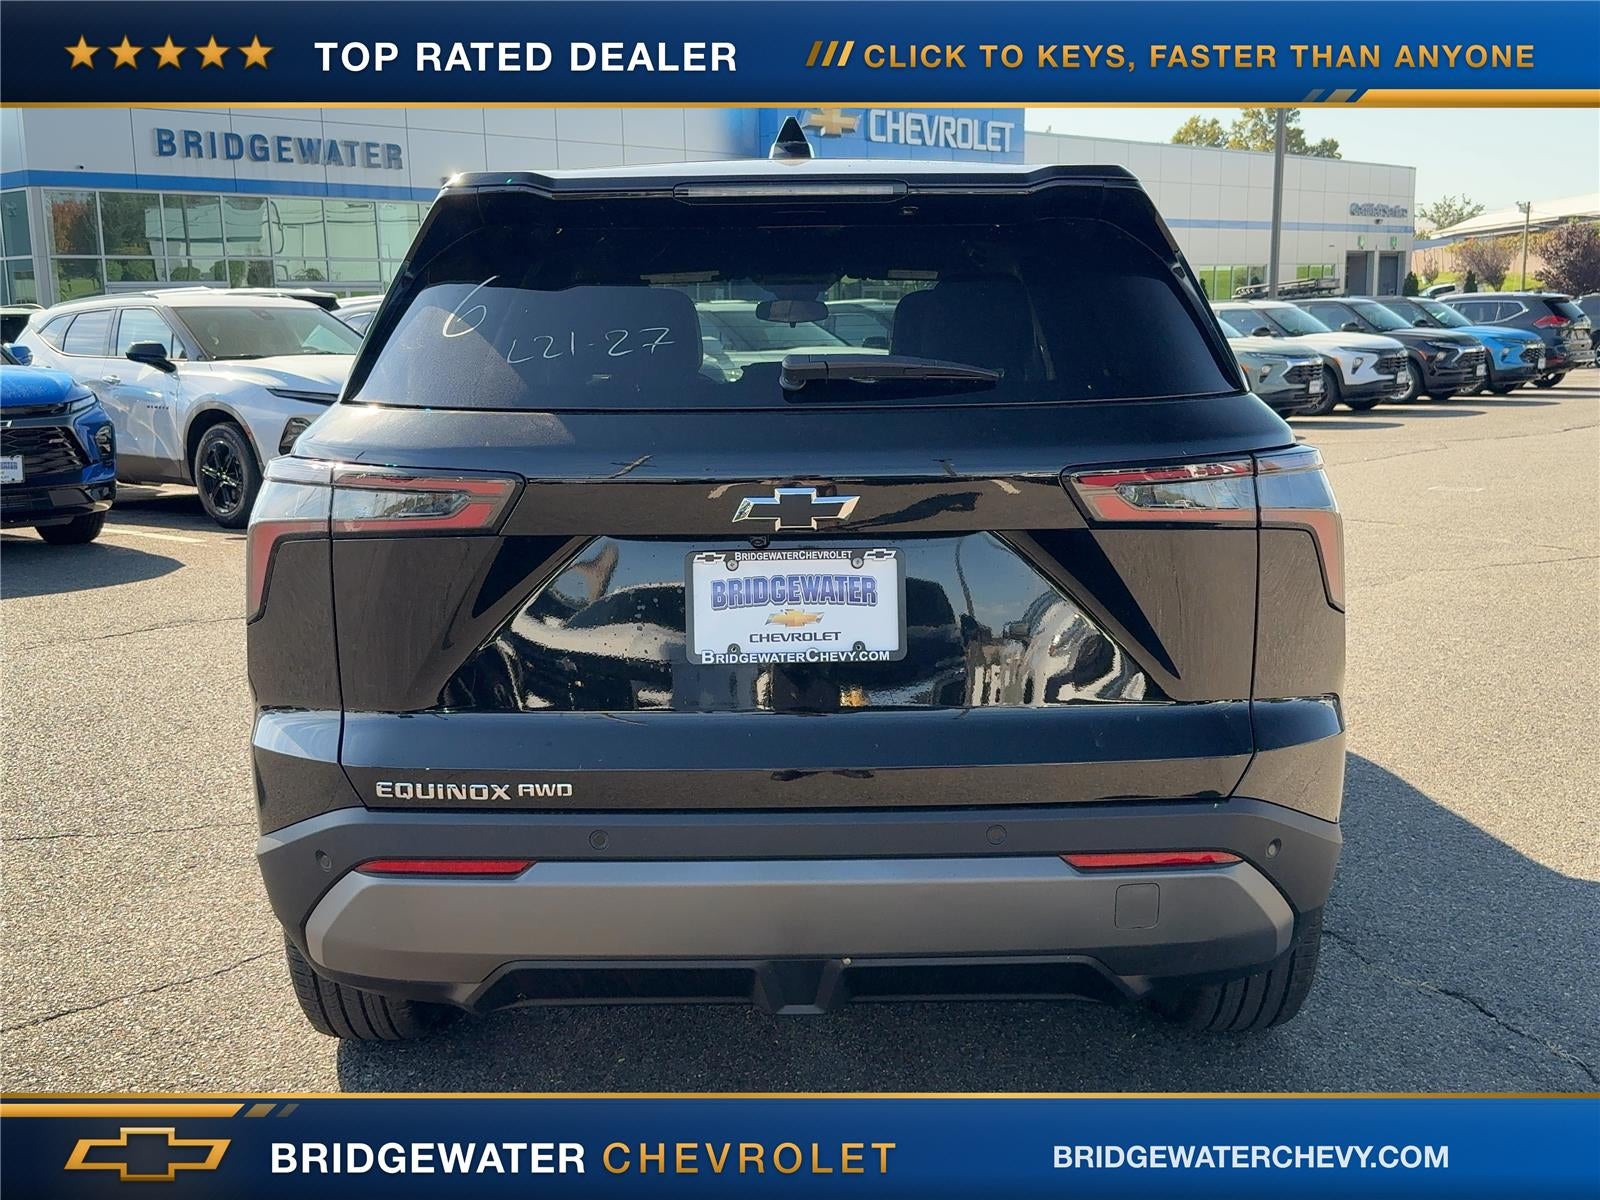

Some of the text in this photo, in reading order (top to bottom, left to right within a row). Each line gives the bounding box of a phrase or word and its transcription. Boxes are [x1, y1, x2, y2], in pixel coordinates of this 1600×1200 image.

[154, 127, 404, 170] BRIDGEWATER
[868, 109, 1015, 152] CHEVROLET
[442, 275, 499, 337] 6
[711, 574, 878, 611] BRIDGEWATER
[749, 631, 842, 643] CHEVROLET
[375, 781, 573, 800] EQUINOX AWD
